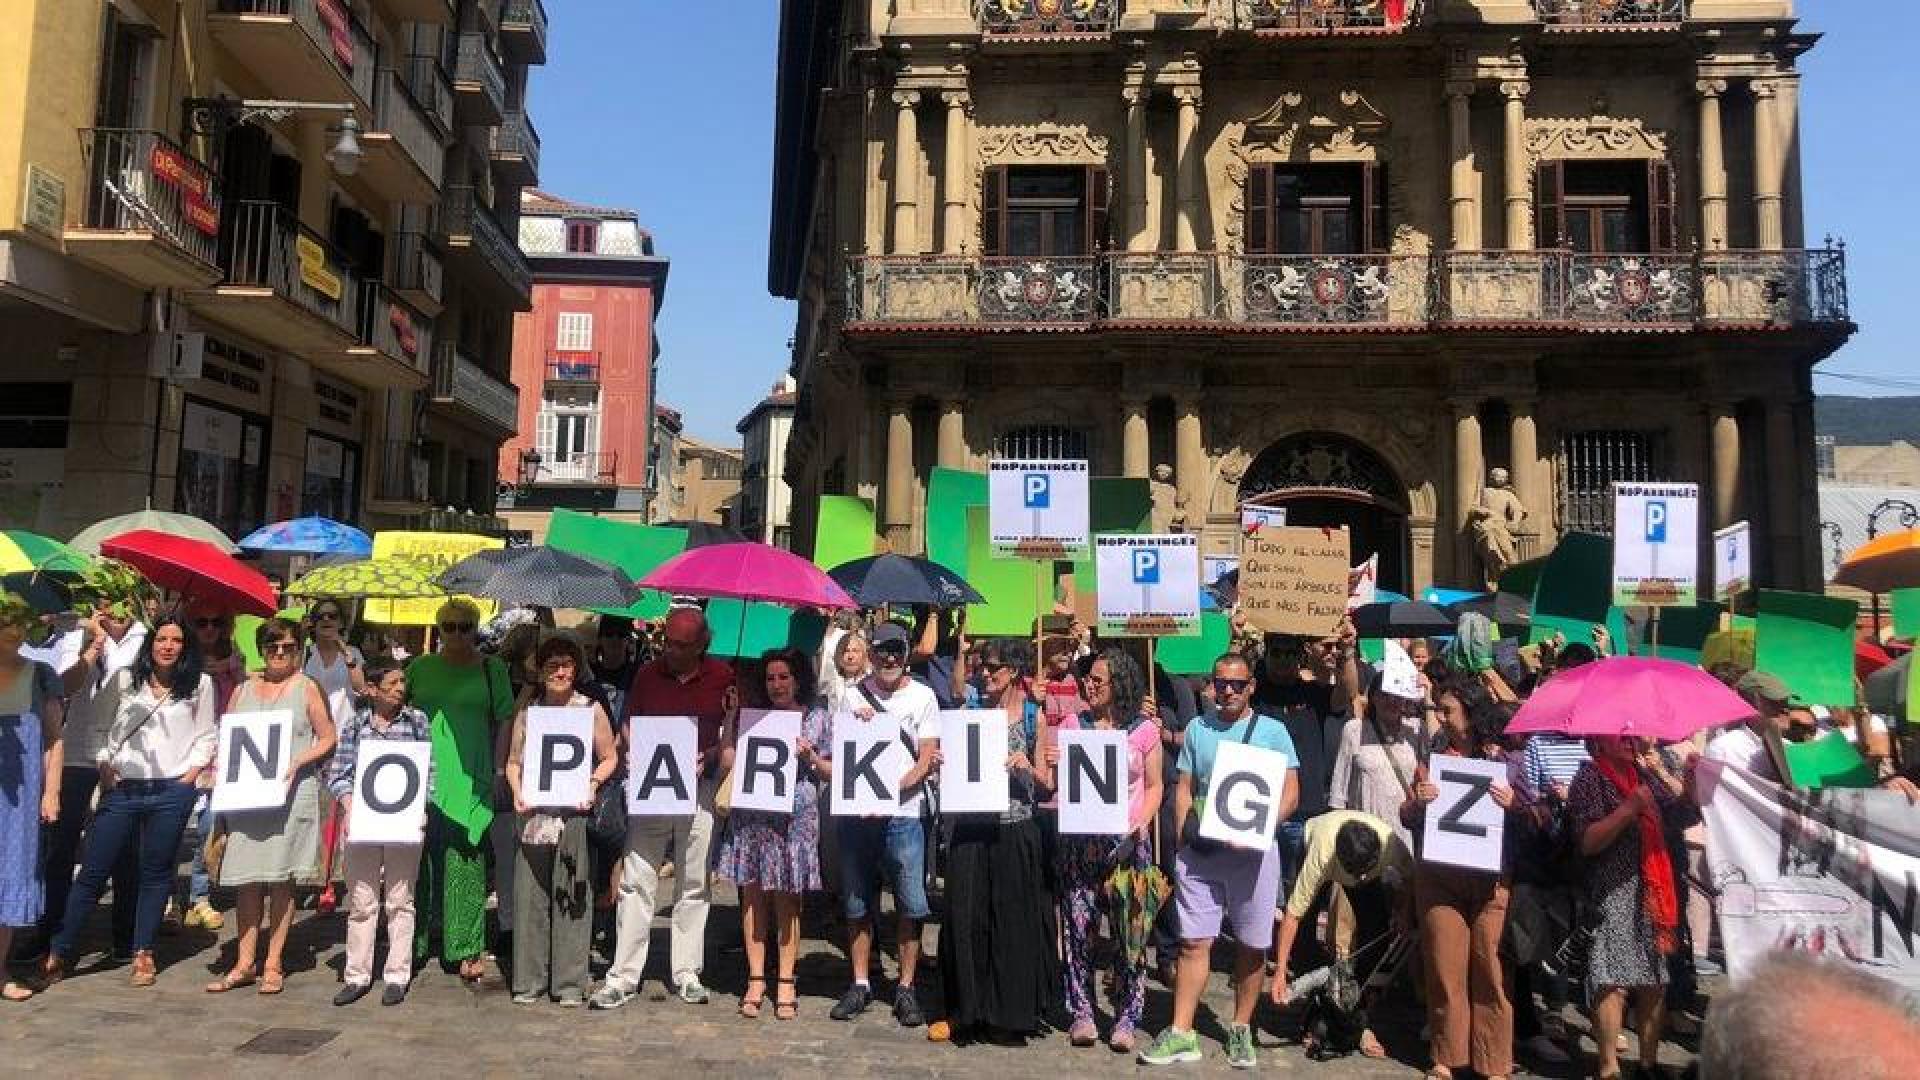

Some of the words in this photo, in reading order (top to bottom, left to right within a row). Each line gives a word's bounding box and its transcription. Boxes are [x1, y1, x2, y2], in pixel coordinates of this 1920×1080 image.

[227, 723, 281, 782] N
[361, 754, 419, 813] O
[1437, 769, 1494, 837] Z
